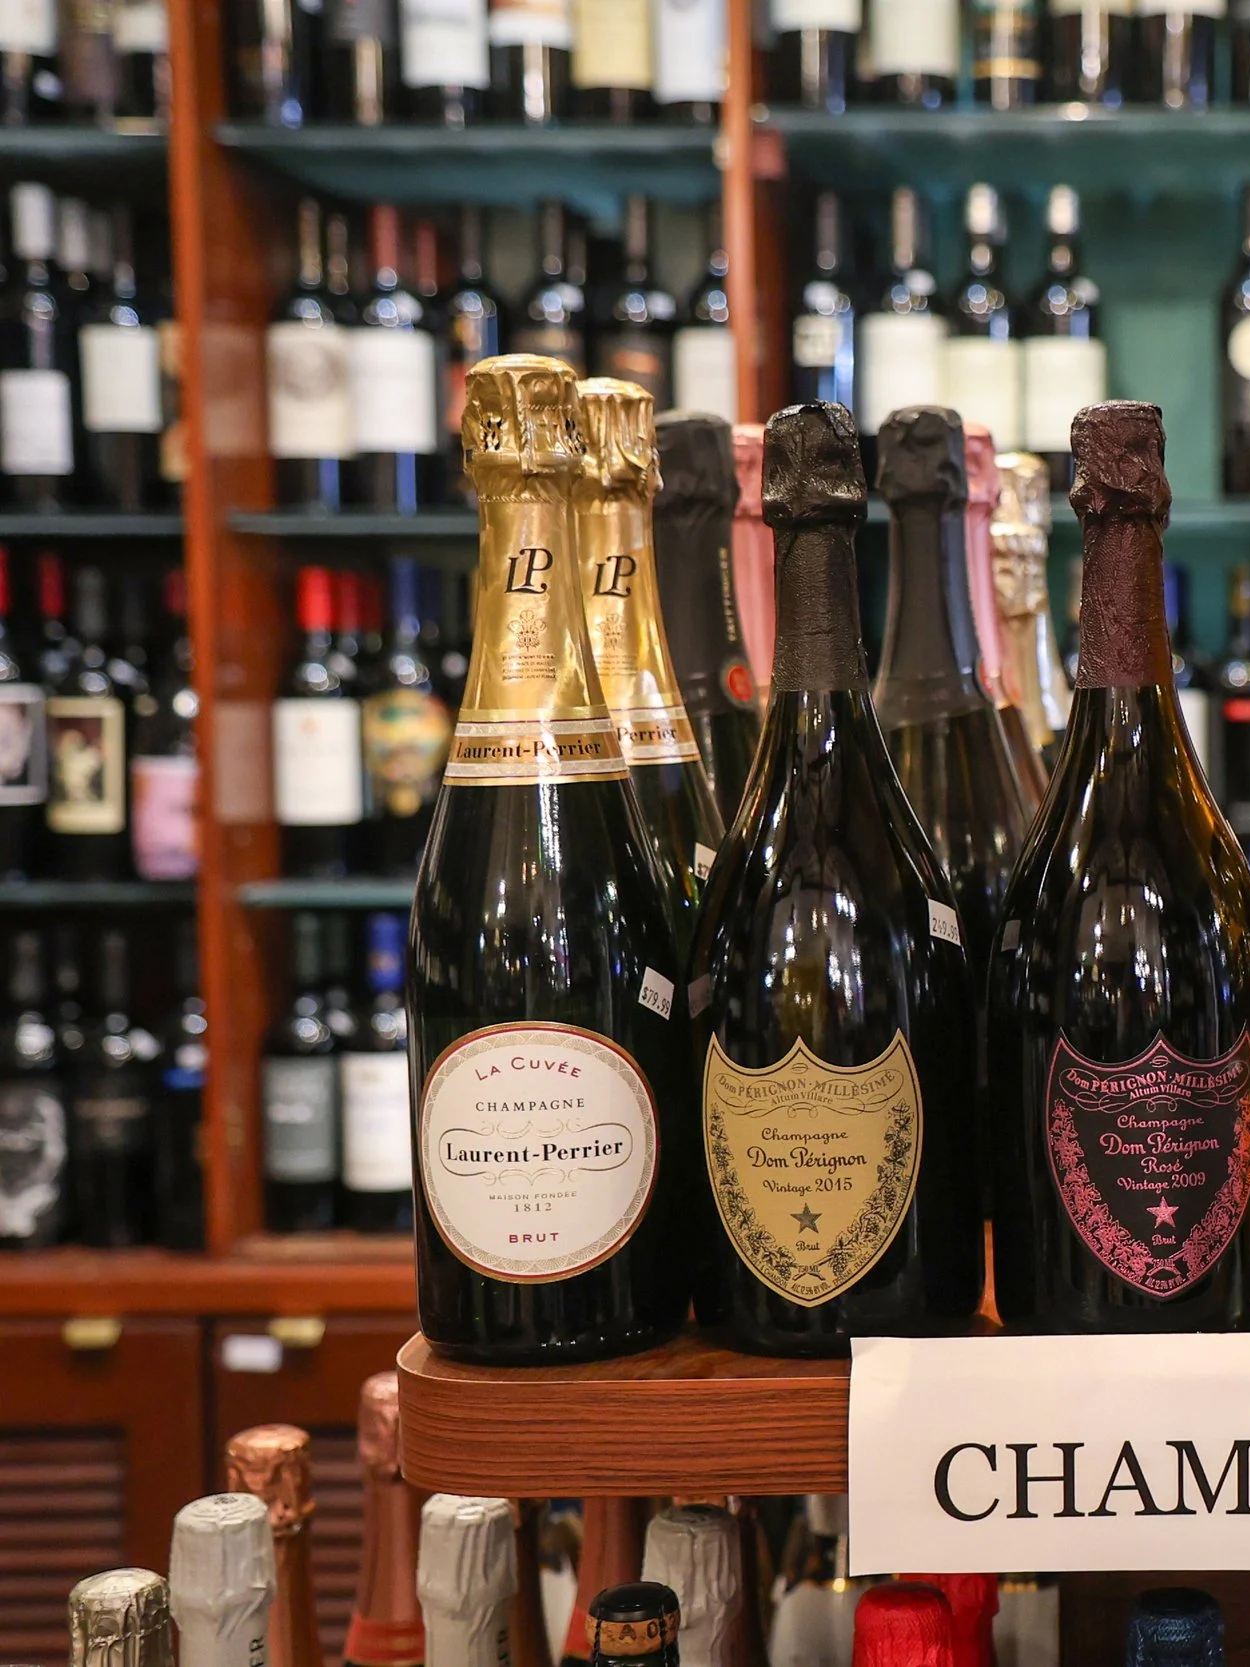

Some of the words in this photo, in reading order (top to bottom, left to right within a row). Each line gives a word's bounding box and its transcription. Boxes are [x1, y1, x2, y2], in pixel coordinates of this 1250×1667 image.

[504, 548, 553, 594] LP
[456, 740, 601, 760] Laurent-Perrier
[641, 985, 671, 1016] $79.99
[475, 1065, 501, 1081] LA
[511, 1056, 582, 1078] CUVÉE
[718, 1075, 737, 1094] Dom
[1067, 1068, 1090, 1090] Dom
[770, 1091, 799, 1106] Altum
[800, 1091, 834, 1105] Villare
[1129, 1085, 1159, 1100] Altum
[1160, 1084, 1192, 1098] Villare
[475, 1098, 585, 1112] CHAMPAGNE
[1117, 1115, 1204, 1131] Champagne
[761, 1127, 848, 1144] Champagne
[447, 1140, 623, 1163] Laurent-Perrier
[1100, 1132, 1146, 1156] Dom
[1147, 1132, 1220, 1159] Pérignon
[747, 1145, 789, 1168] Dom
[790, 1146, 867, 1174] Pérignon
[1140, 1156, 1184, 1174] Rosé
[763, 1179, 812, 1196] Vintage
[815, 1177, 853, 1193] 2015
[1117, 1177, 1169, 1193] Vintage
[1171, 1172, 1206, 1189] 2009
[514, 1202, 553, 1213] 1812
[509, 1233, 559, 1243] BRUT
[796, 1240, 820, 1252] Brut
[1152, 1234, 1177, 1246] Brut
